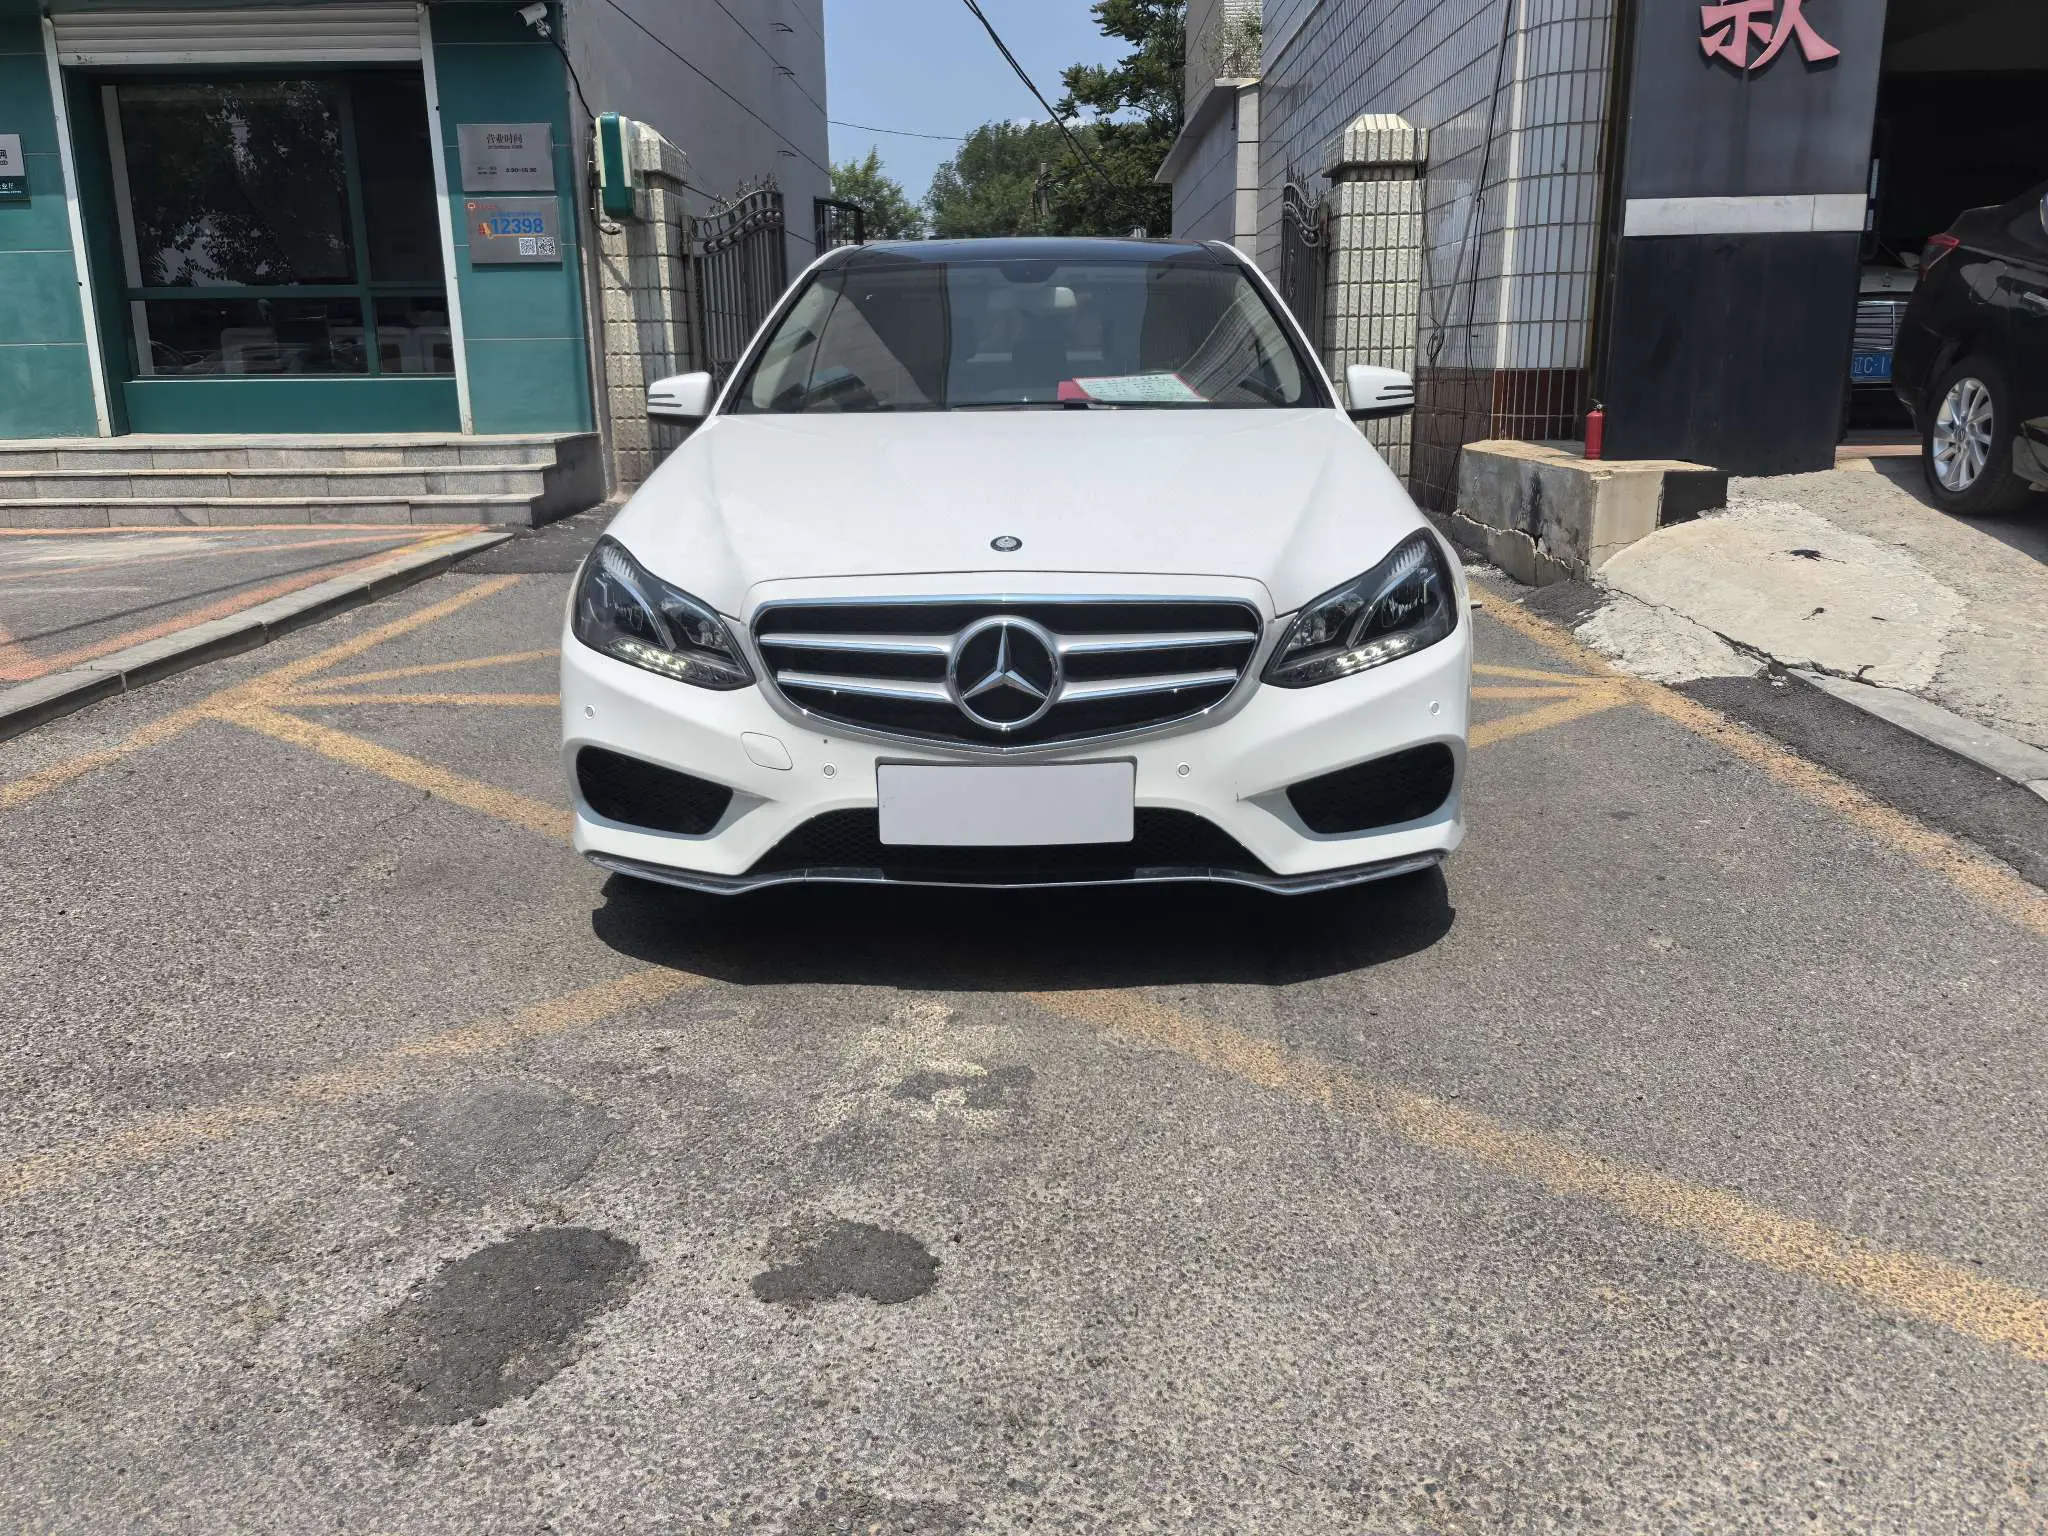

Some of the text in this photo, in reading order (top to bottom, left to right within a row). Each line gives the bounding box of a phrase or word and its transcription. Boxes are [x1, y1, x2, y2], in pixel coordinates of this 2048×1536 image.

[486, 132, 523, 144] 营业时间
[490, 217, 544, 235] 12398
